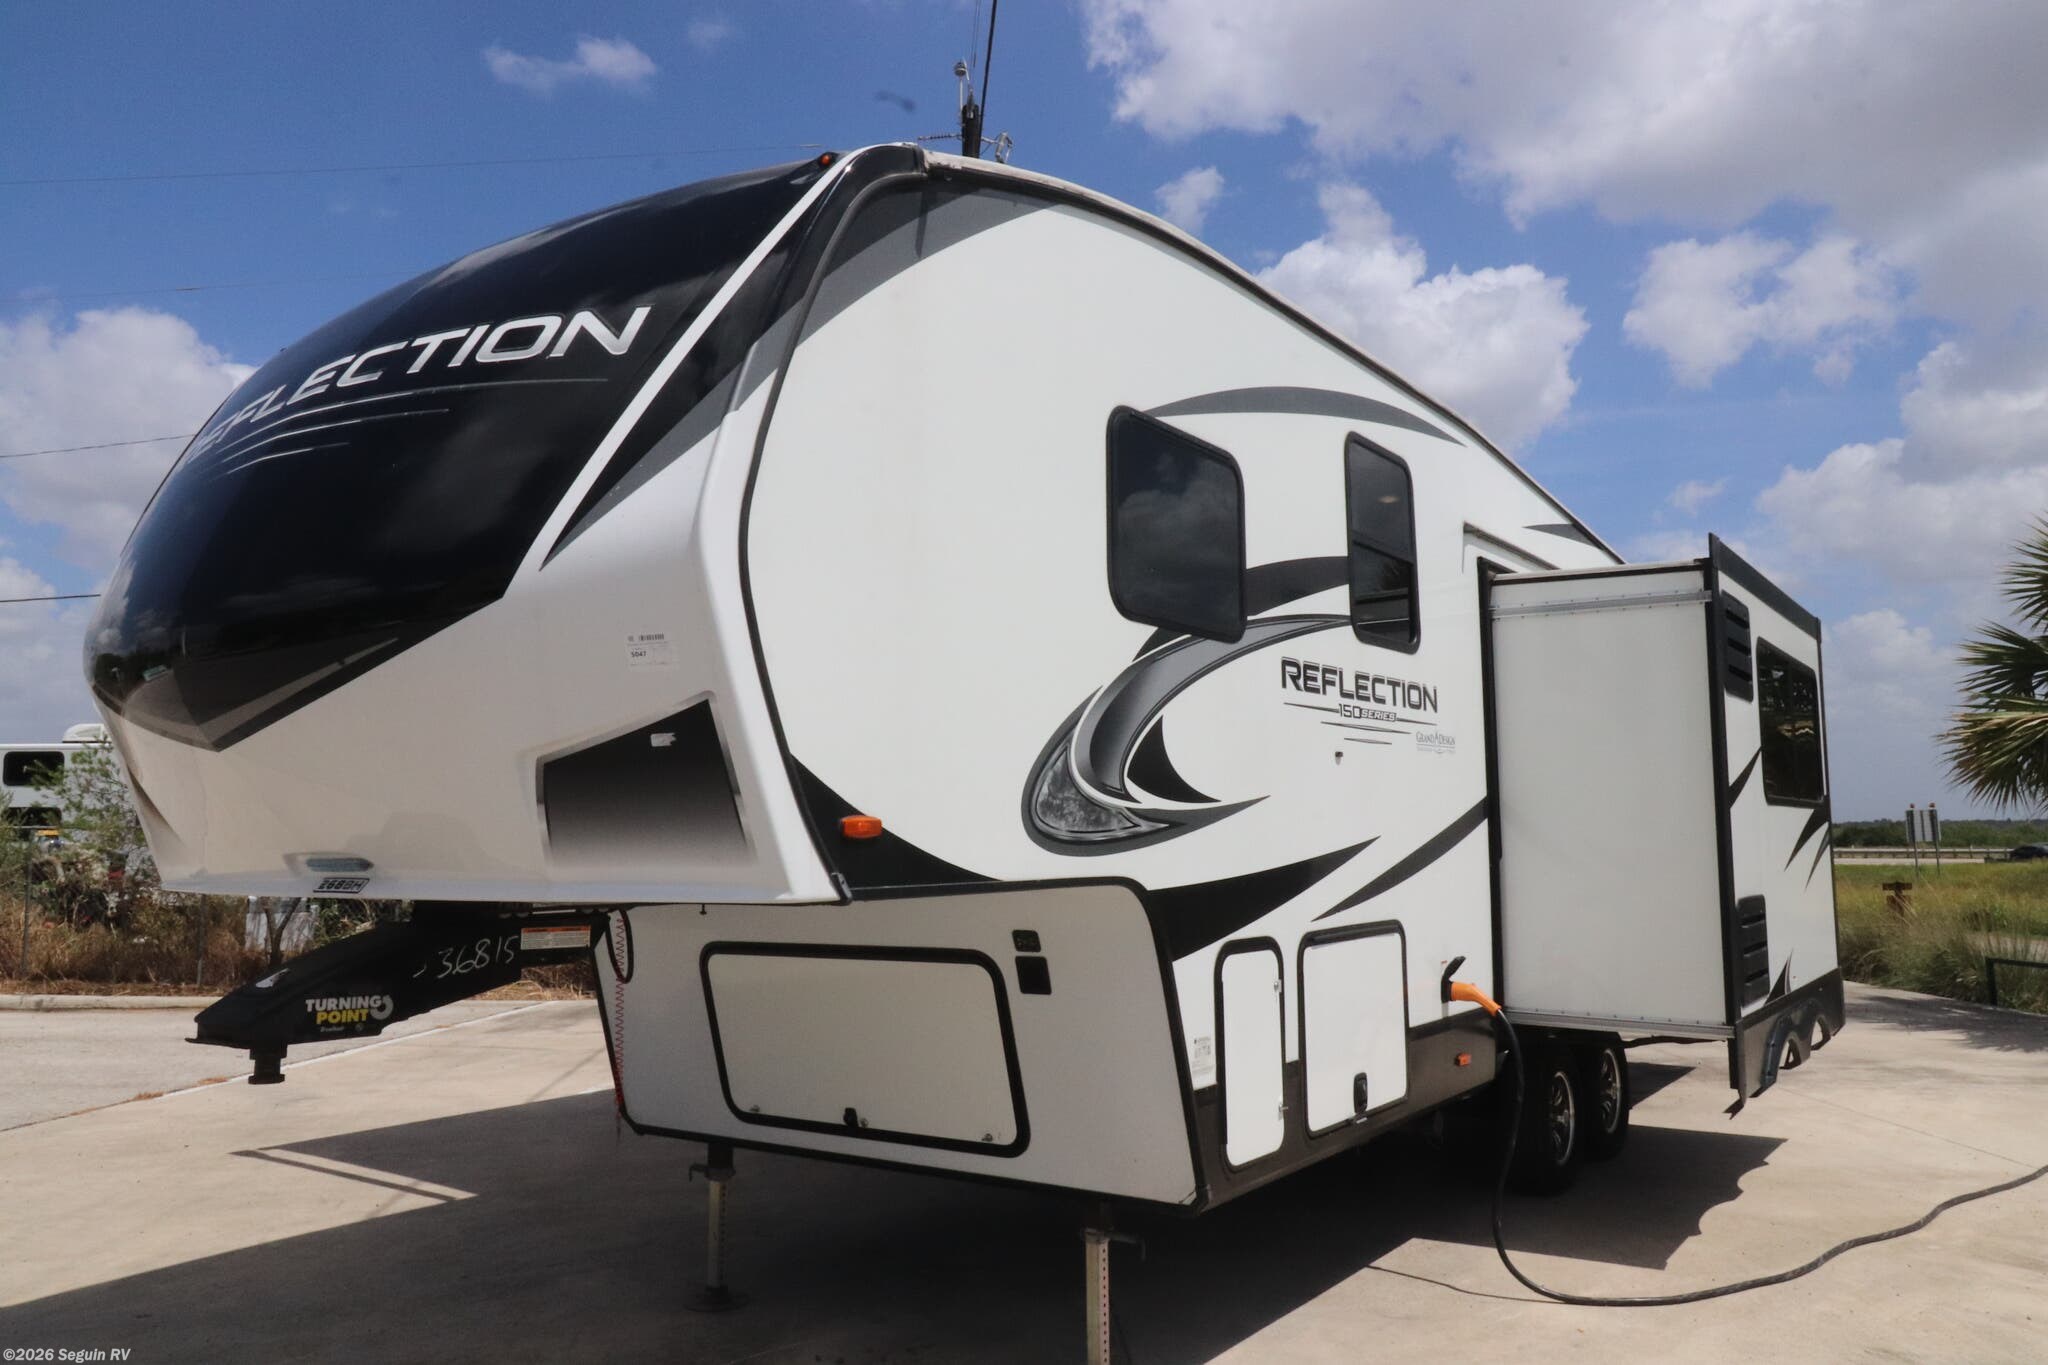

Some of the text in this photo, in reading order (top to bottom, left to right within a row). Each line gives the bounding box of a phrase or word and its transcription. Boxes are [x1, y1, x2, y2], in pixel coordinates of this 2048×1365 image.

[1281, 656, 1438, 714] REFLECTION
[305, 995, 382, 1012] TURNING
[316, 1008, 369, 1024] POINT
